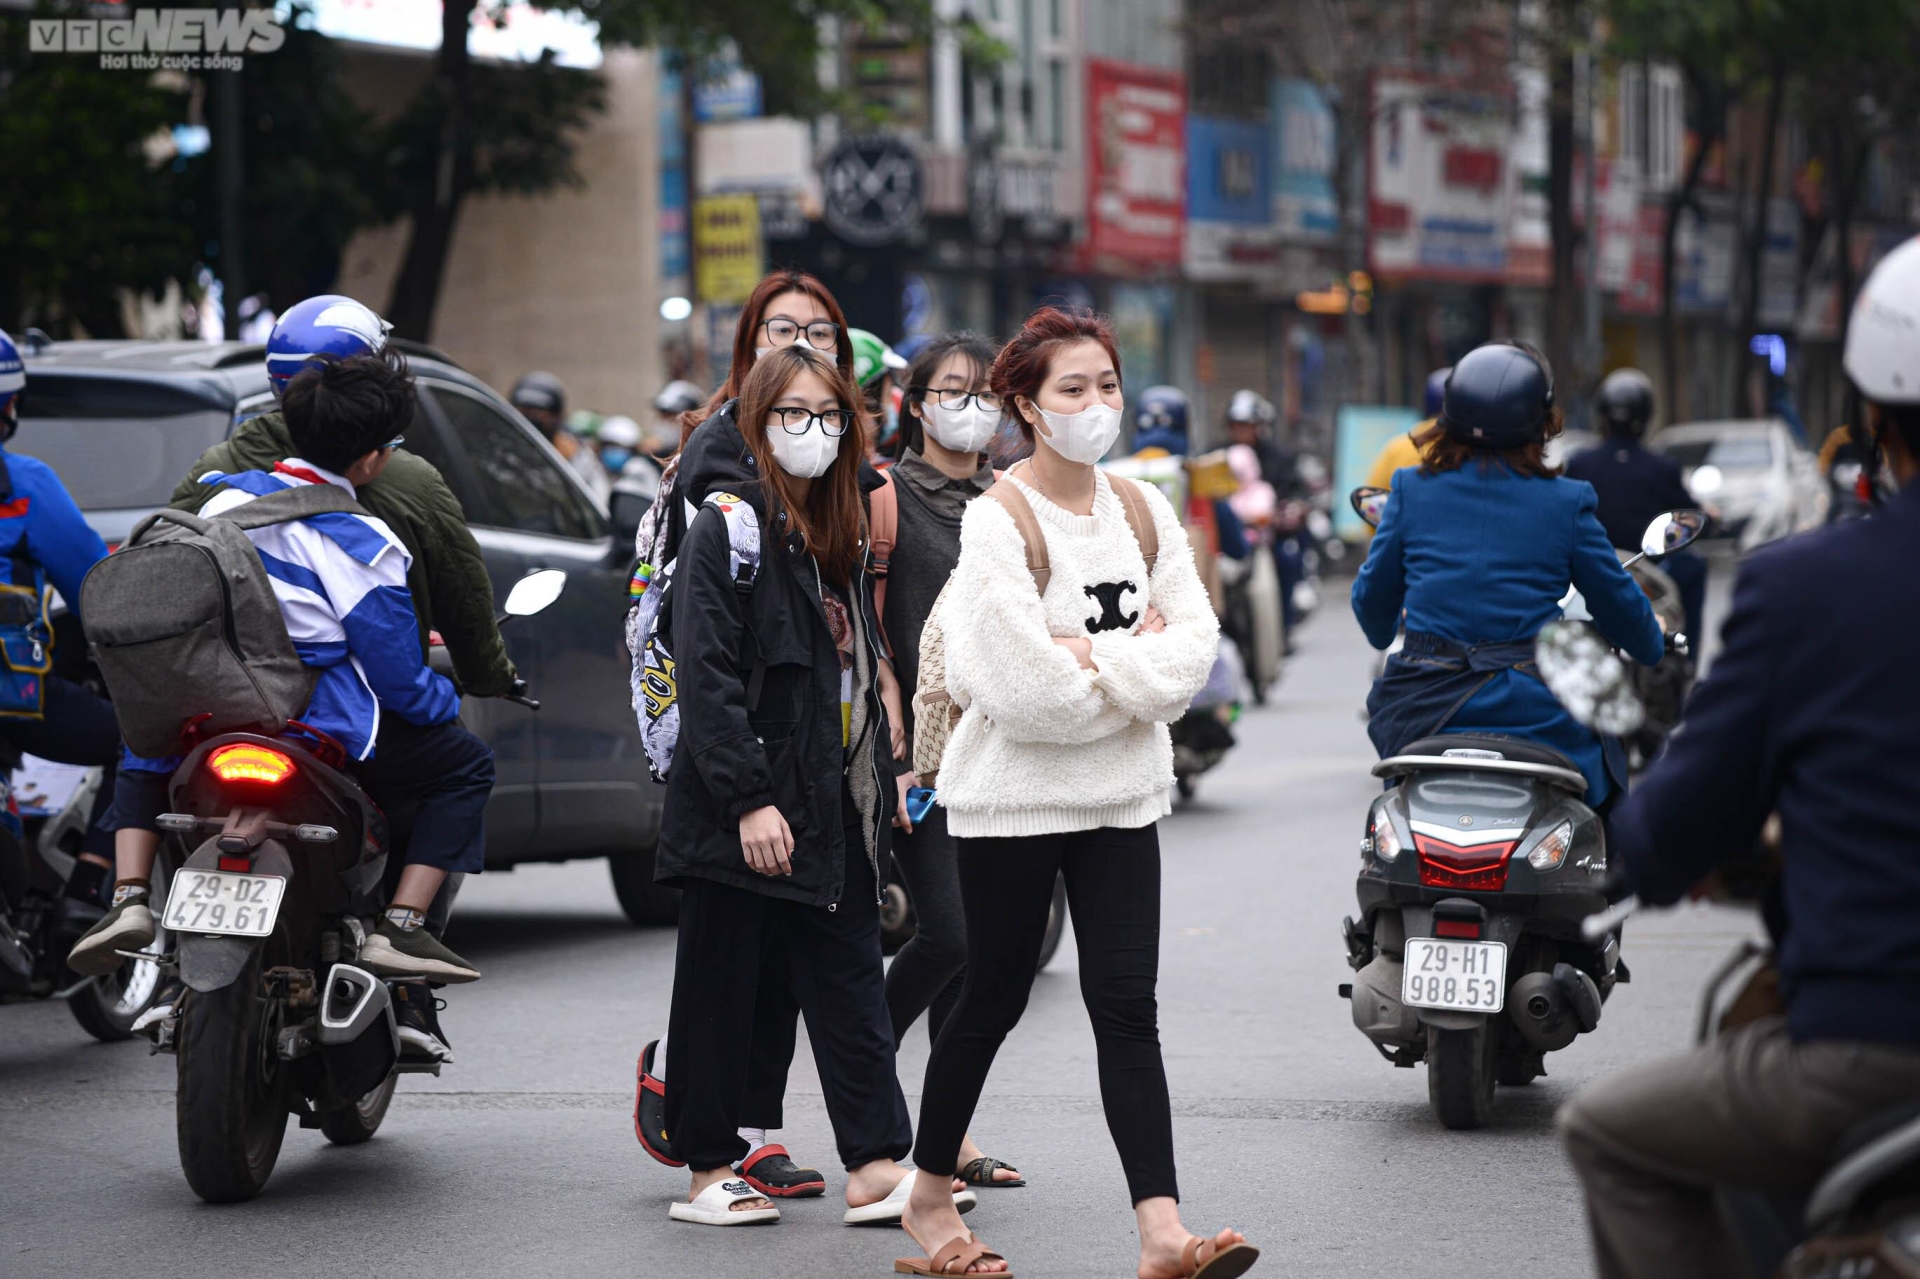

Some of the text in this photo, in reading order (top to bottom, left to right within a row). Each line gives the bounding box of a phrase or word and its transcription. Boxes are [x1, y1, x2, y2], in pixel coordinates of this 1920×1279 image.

[188, 874, 267, 903] 29-D2
[172, 901, 268, 931] 479.61
[1420, 944, 1489, 975] 29-H1
[1410, 975, 1497, 1006] 988.53
